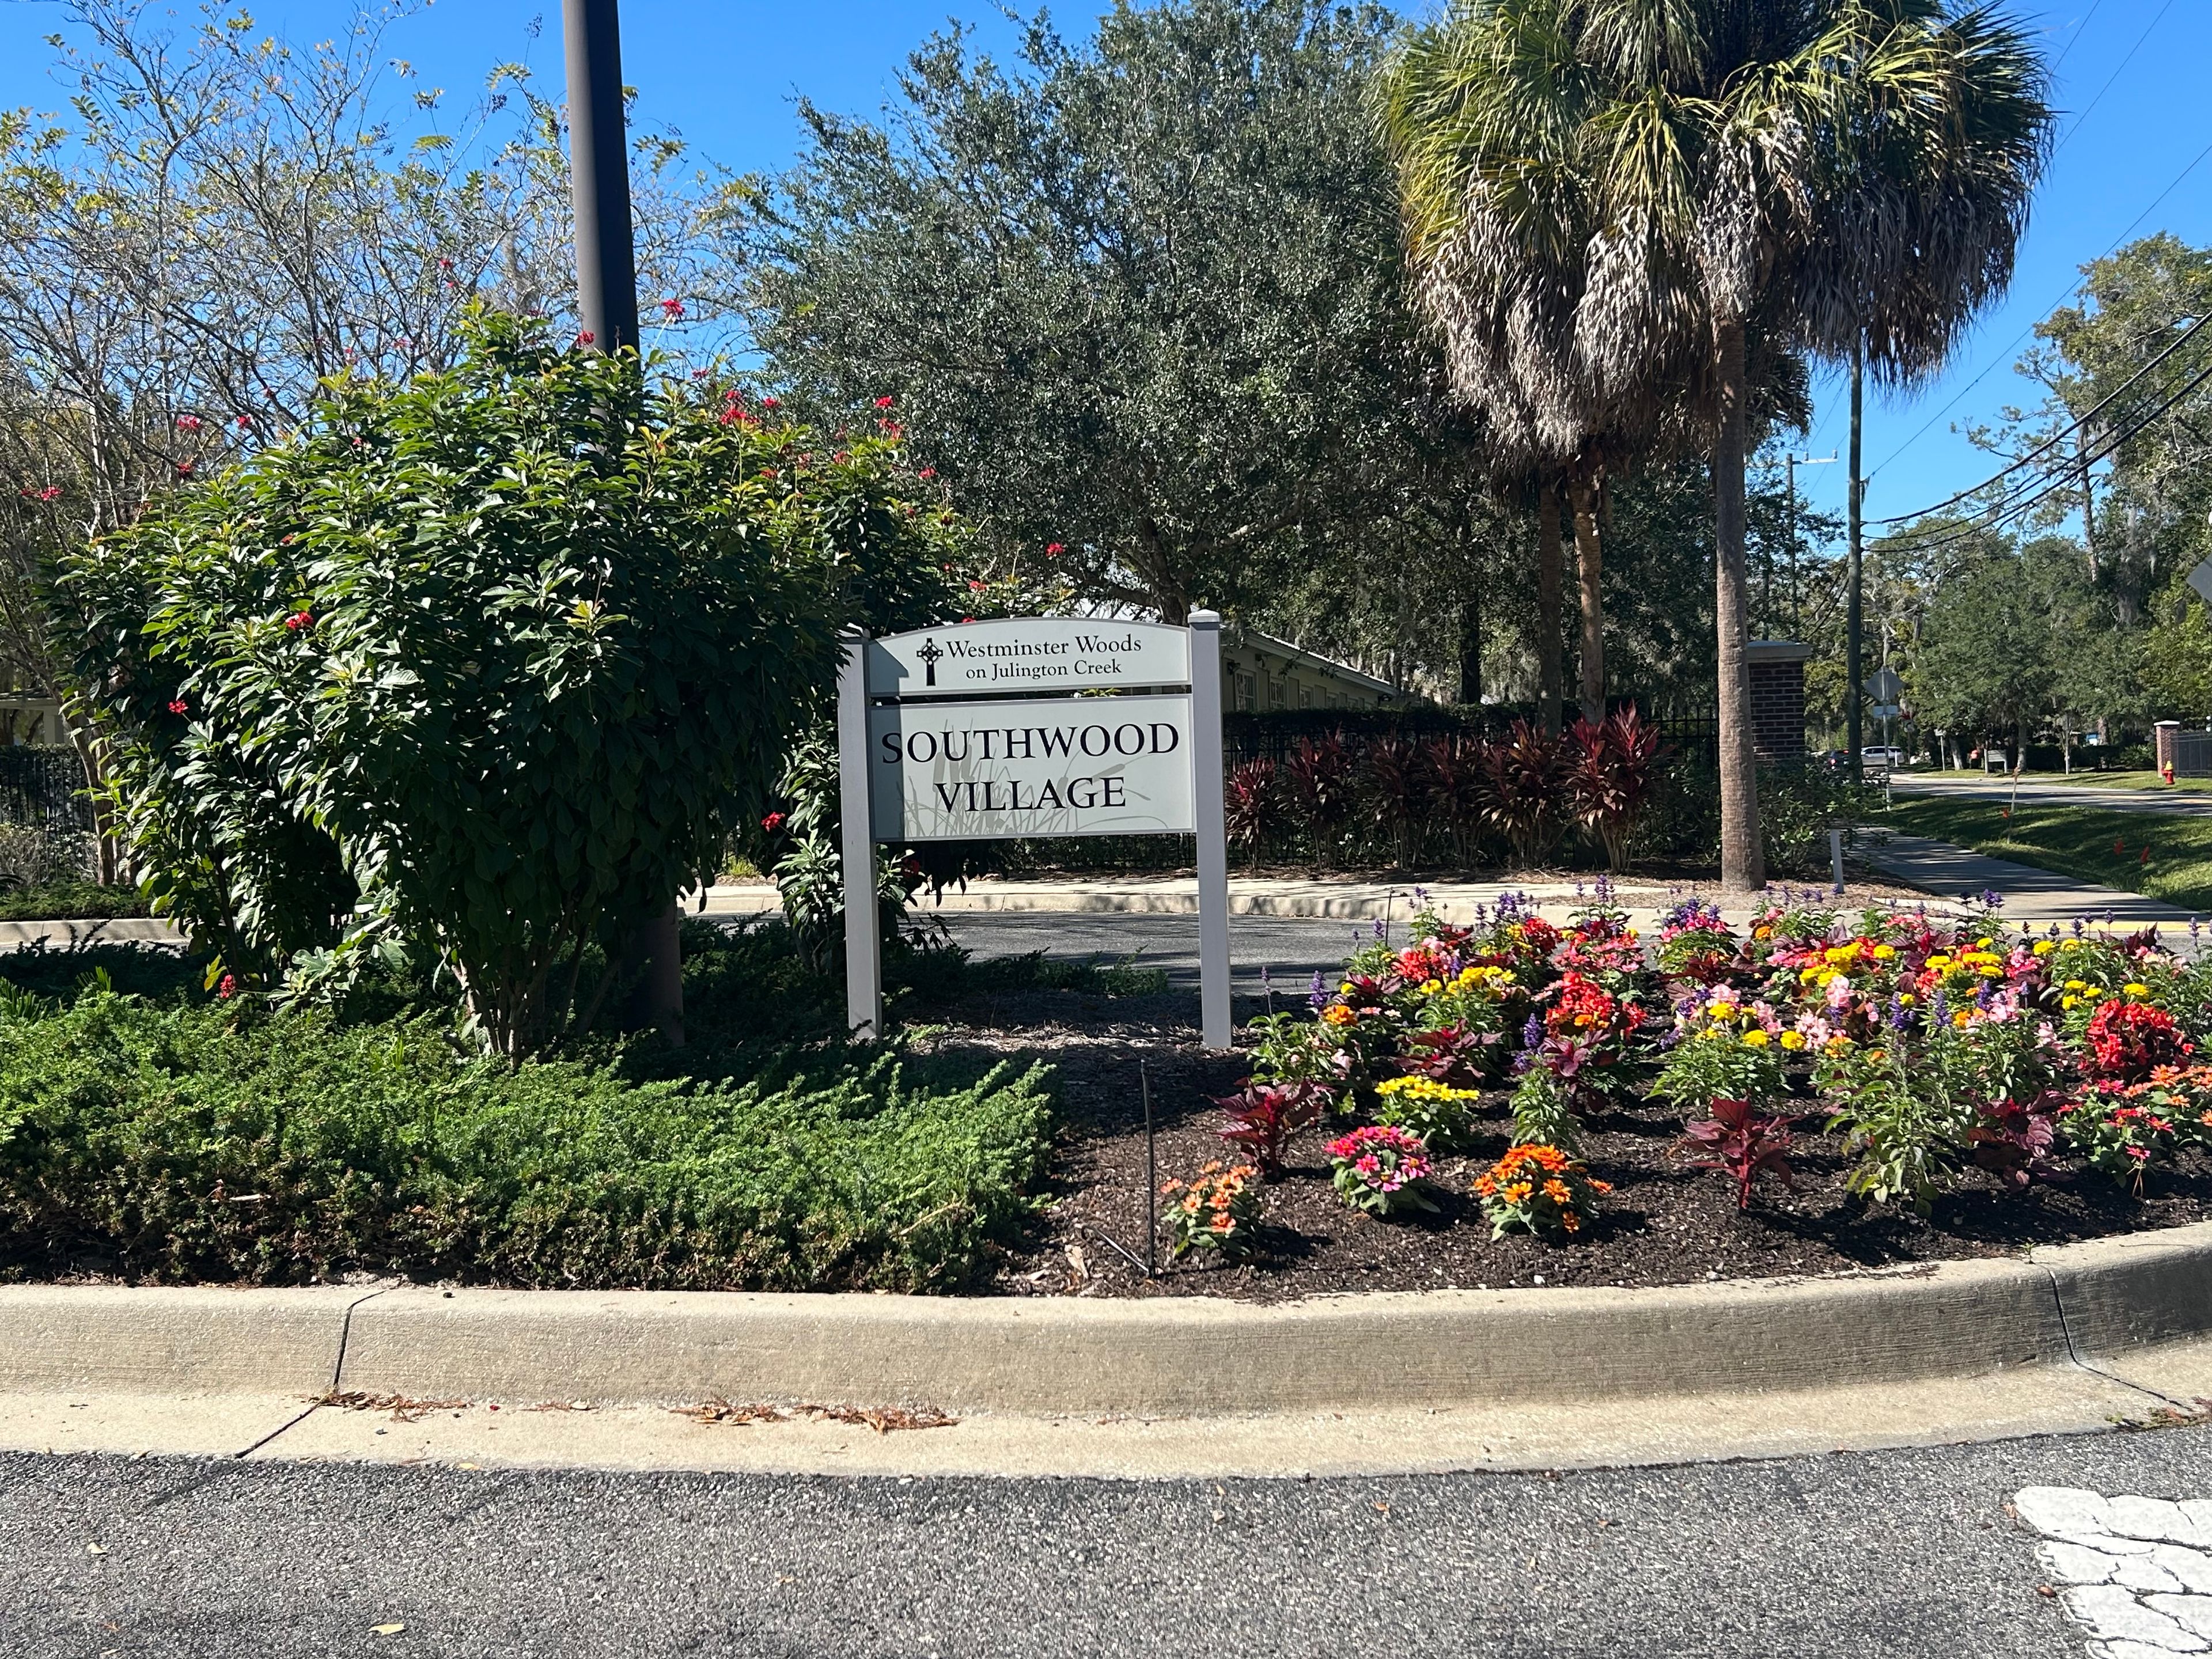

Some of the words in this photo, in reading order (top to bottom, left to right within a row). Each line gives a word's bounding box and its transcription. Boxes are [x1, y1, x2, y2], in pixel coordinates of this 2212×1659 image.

[947, 639, 1069, 658] Westminster
[1075, 634, 1141, 653] Woods
[966, 668, 986, 679] on
[991, 662, 1068, 680] Julington
[1074, 660, 1122, 675] Creek
[881, 723, 1179, 763] SOUTHWOOD
[935, 777, 1126, 813] VILLAGE
